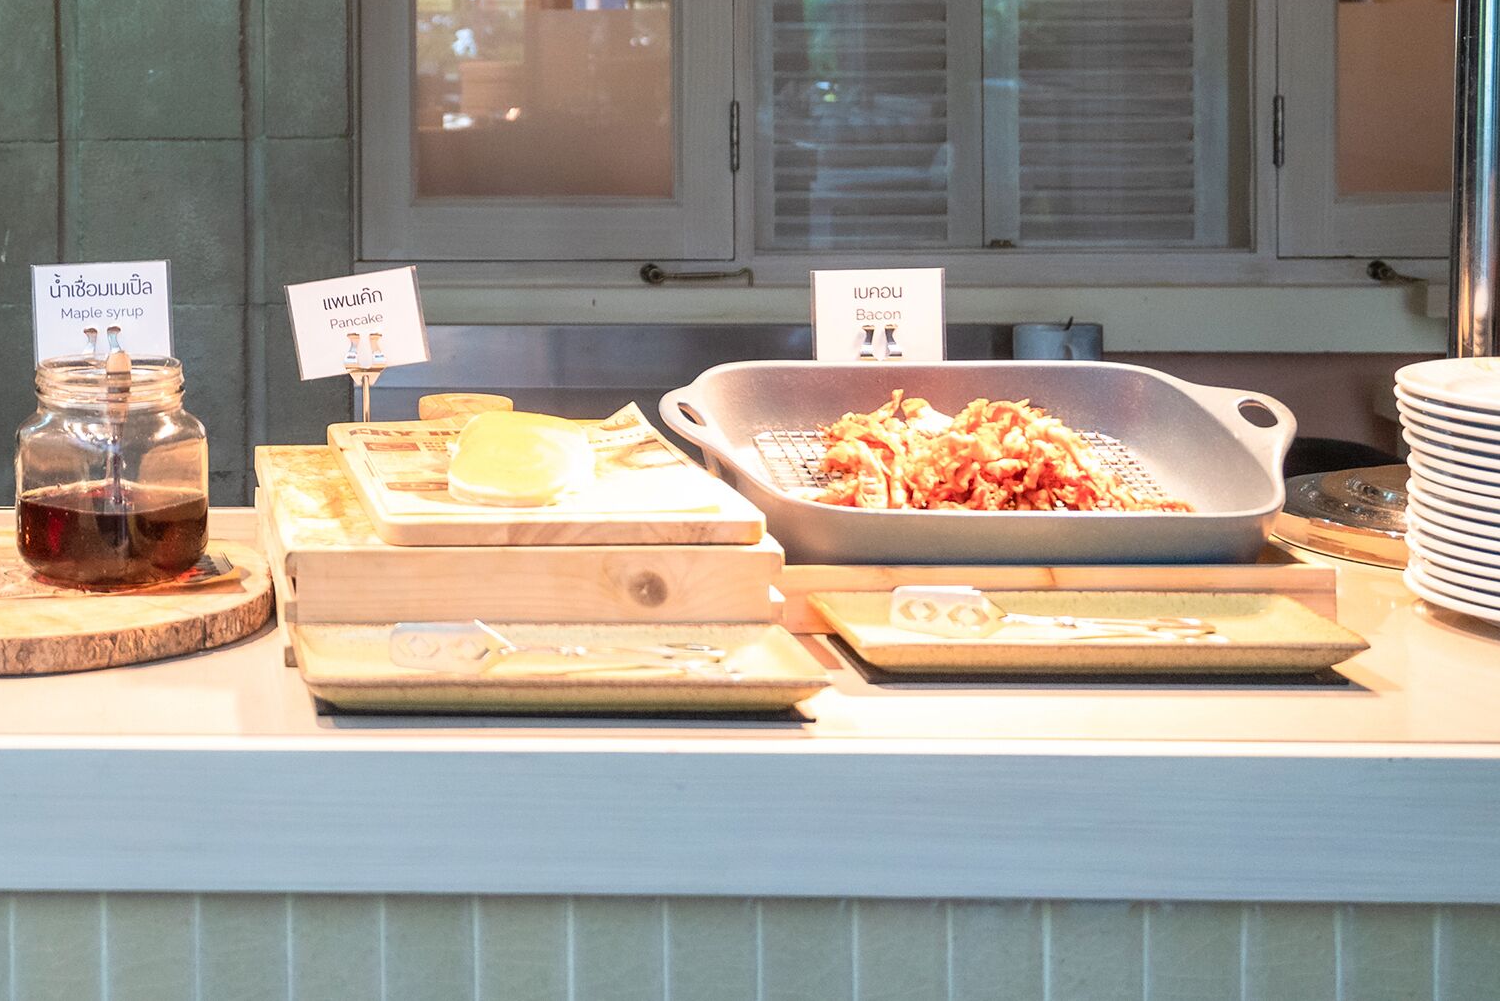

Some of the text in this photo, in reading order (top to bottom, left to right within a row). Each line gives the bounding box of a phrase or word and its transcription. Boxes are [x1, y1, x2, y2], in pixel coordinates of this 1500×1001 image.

[853, 286, 903, 300] เบคอน
[61, 306, 144, 321] Maple syrup
[329, 312, 384, 329] Pancake
[856, 308, 902, 321] Bacon
